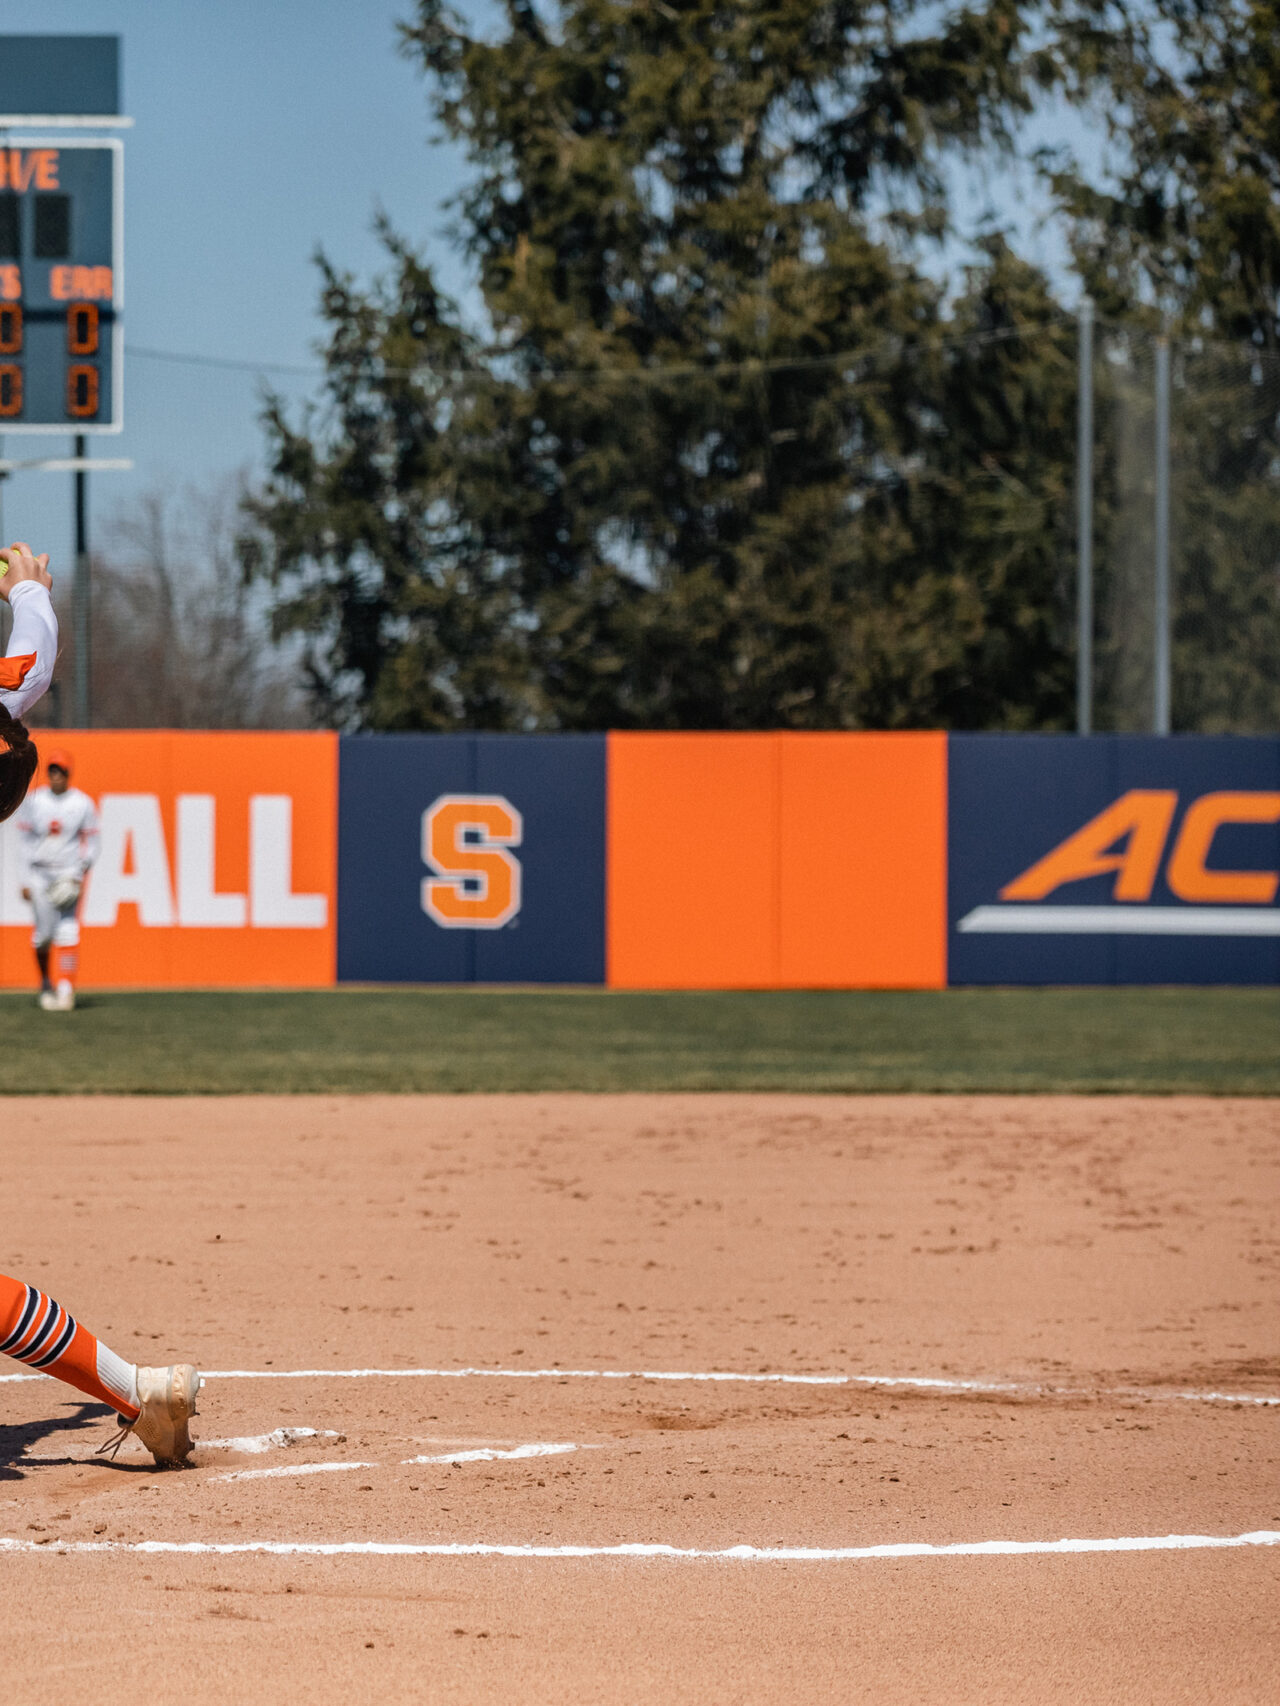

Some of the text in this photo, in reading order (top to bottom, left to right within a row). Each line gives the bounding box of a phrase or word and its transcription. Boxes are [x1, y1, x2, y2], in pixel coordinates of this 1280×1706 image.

[50, 266, 114, 299] ERR
[67, 302, 99, 354] 0
[67, 365, 99, 416] 0
[421, 794, 523, 929] S
